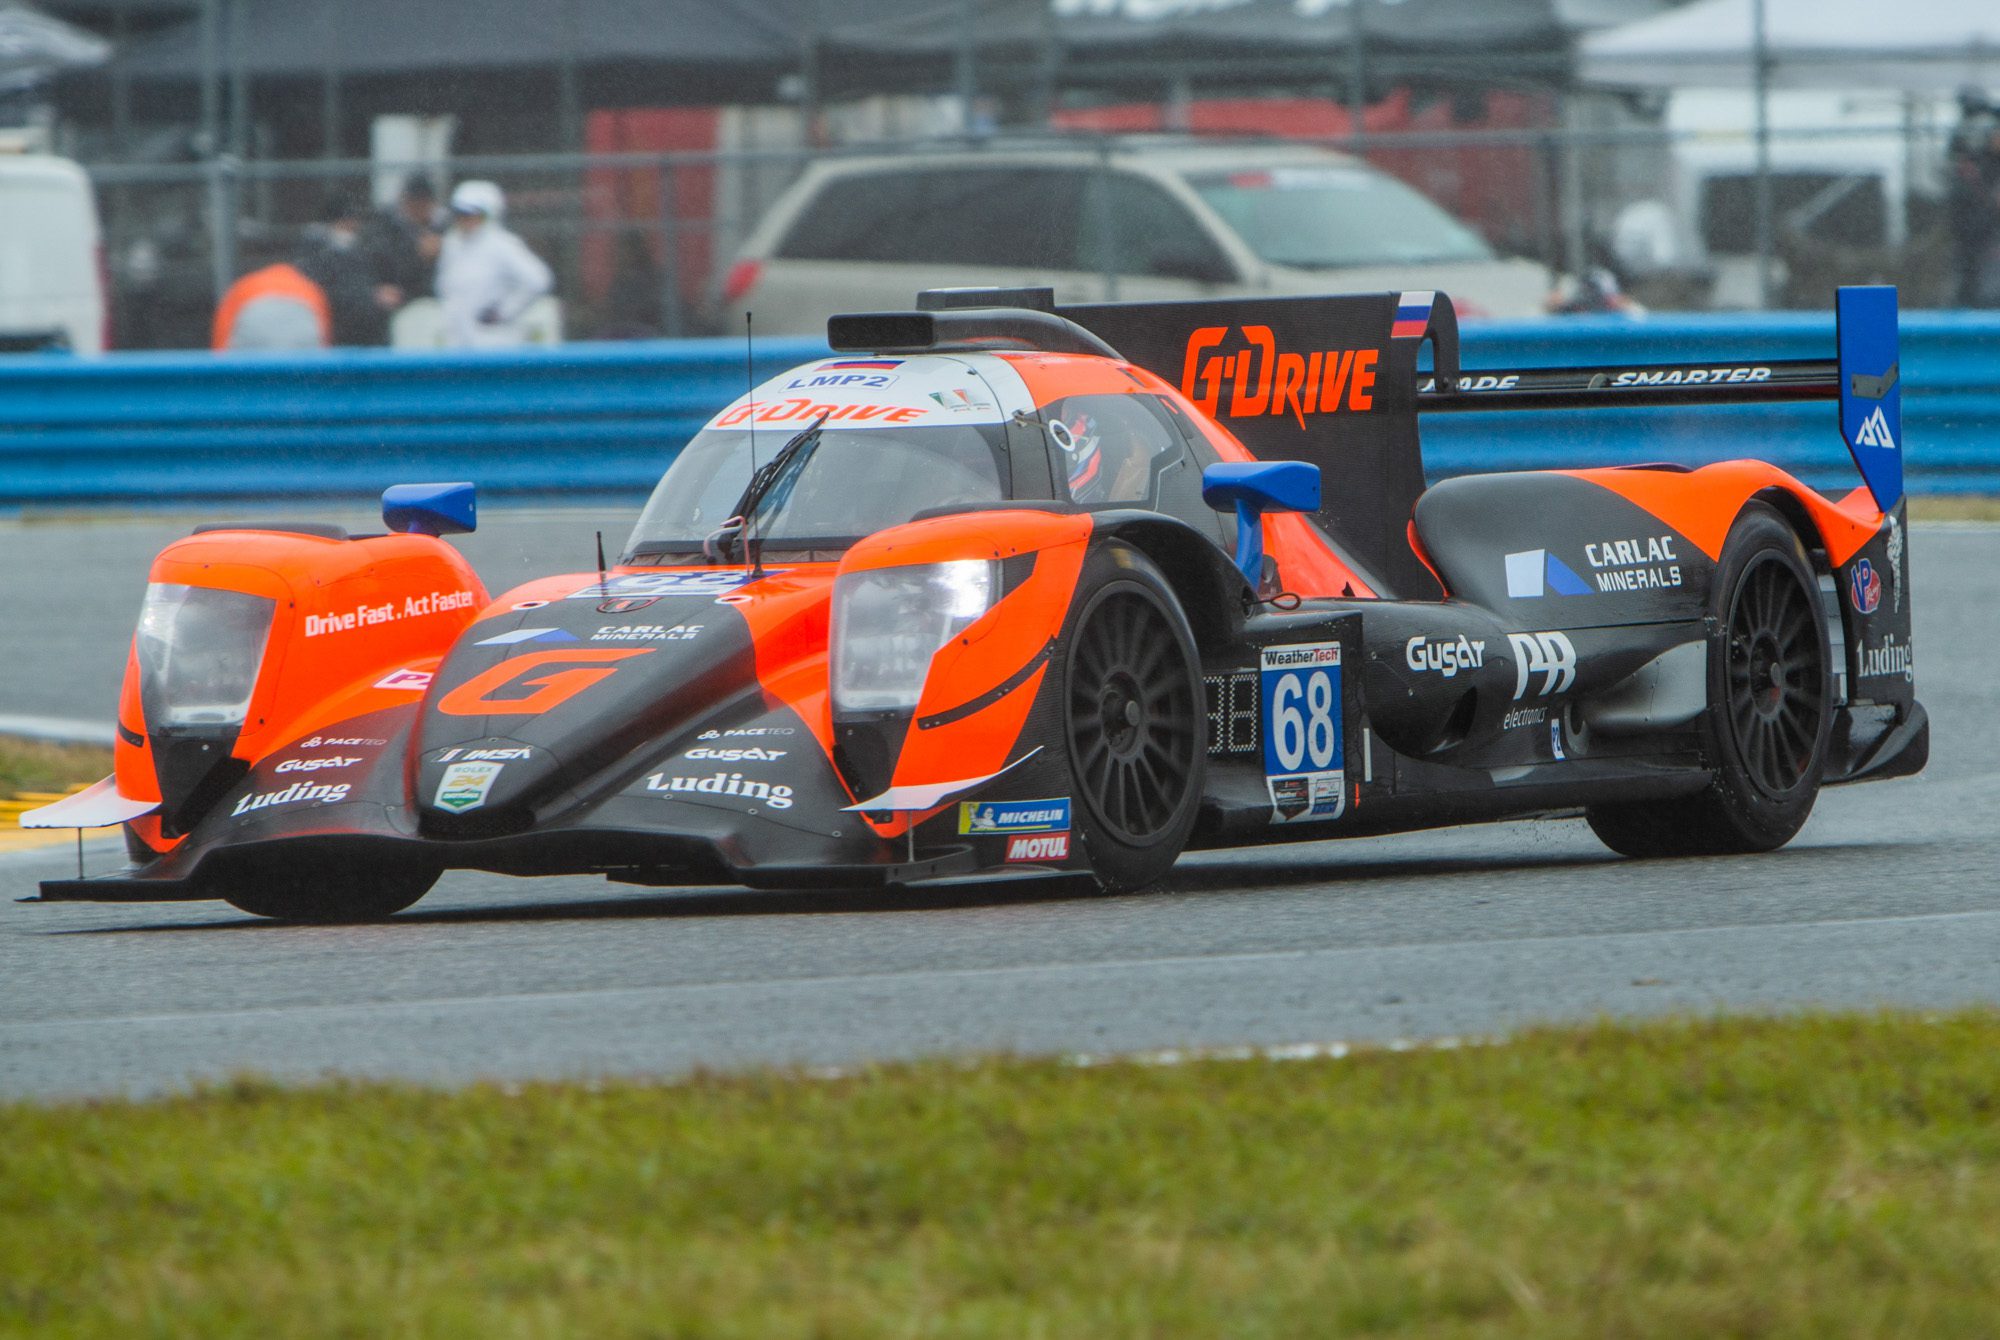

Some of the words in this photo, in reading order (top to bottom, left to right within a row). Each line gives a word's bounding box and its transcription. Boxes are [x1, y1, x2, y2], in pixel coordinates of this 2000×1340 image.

[788, 375, 889, 389] LMP2
[1611, 367, 1772, 387] SMARTER
[1585, 536, 1677, 567] CARLAC
[617, 571, 748, 586] 68
[1595, 566, 1682, 592] MINERALS
[304, 612, 356, 637] Drive
[404, 597, 431, 618] Act
[431, 590, 473, 613] Faster
[590, 632, 698, 641] MINERALS
[597, 625, 704, 633] CARLAC
[1264, 647, 1338, 665] WeatherTech
[1856, 633, 1913, 682] Luding
[1272, 671, 1335, 771] 68
[461, 749, 531, 761] IMSA
[230, 780, 352, 817] Luding
[646, 772, 793, 809] Luding
[998, 809, 1065, 824] MICHELIN
[1009, 837, 1067, 859] MOTUL
